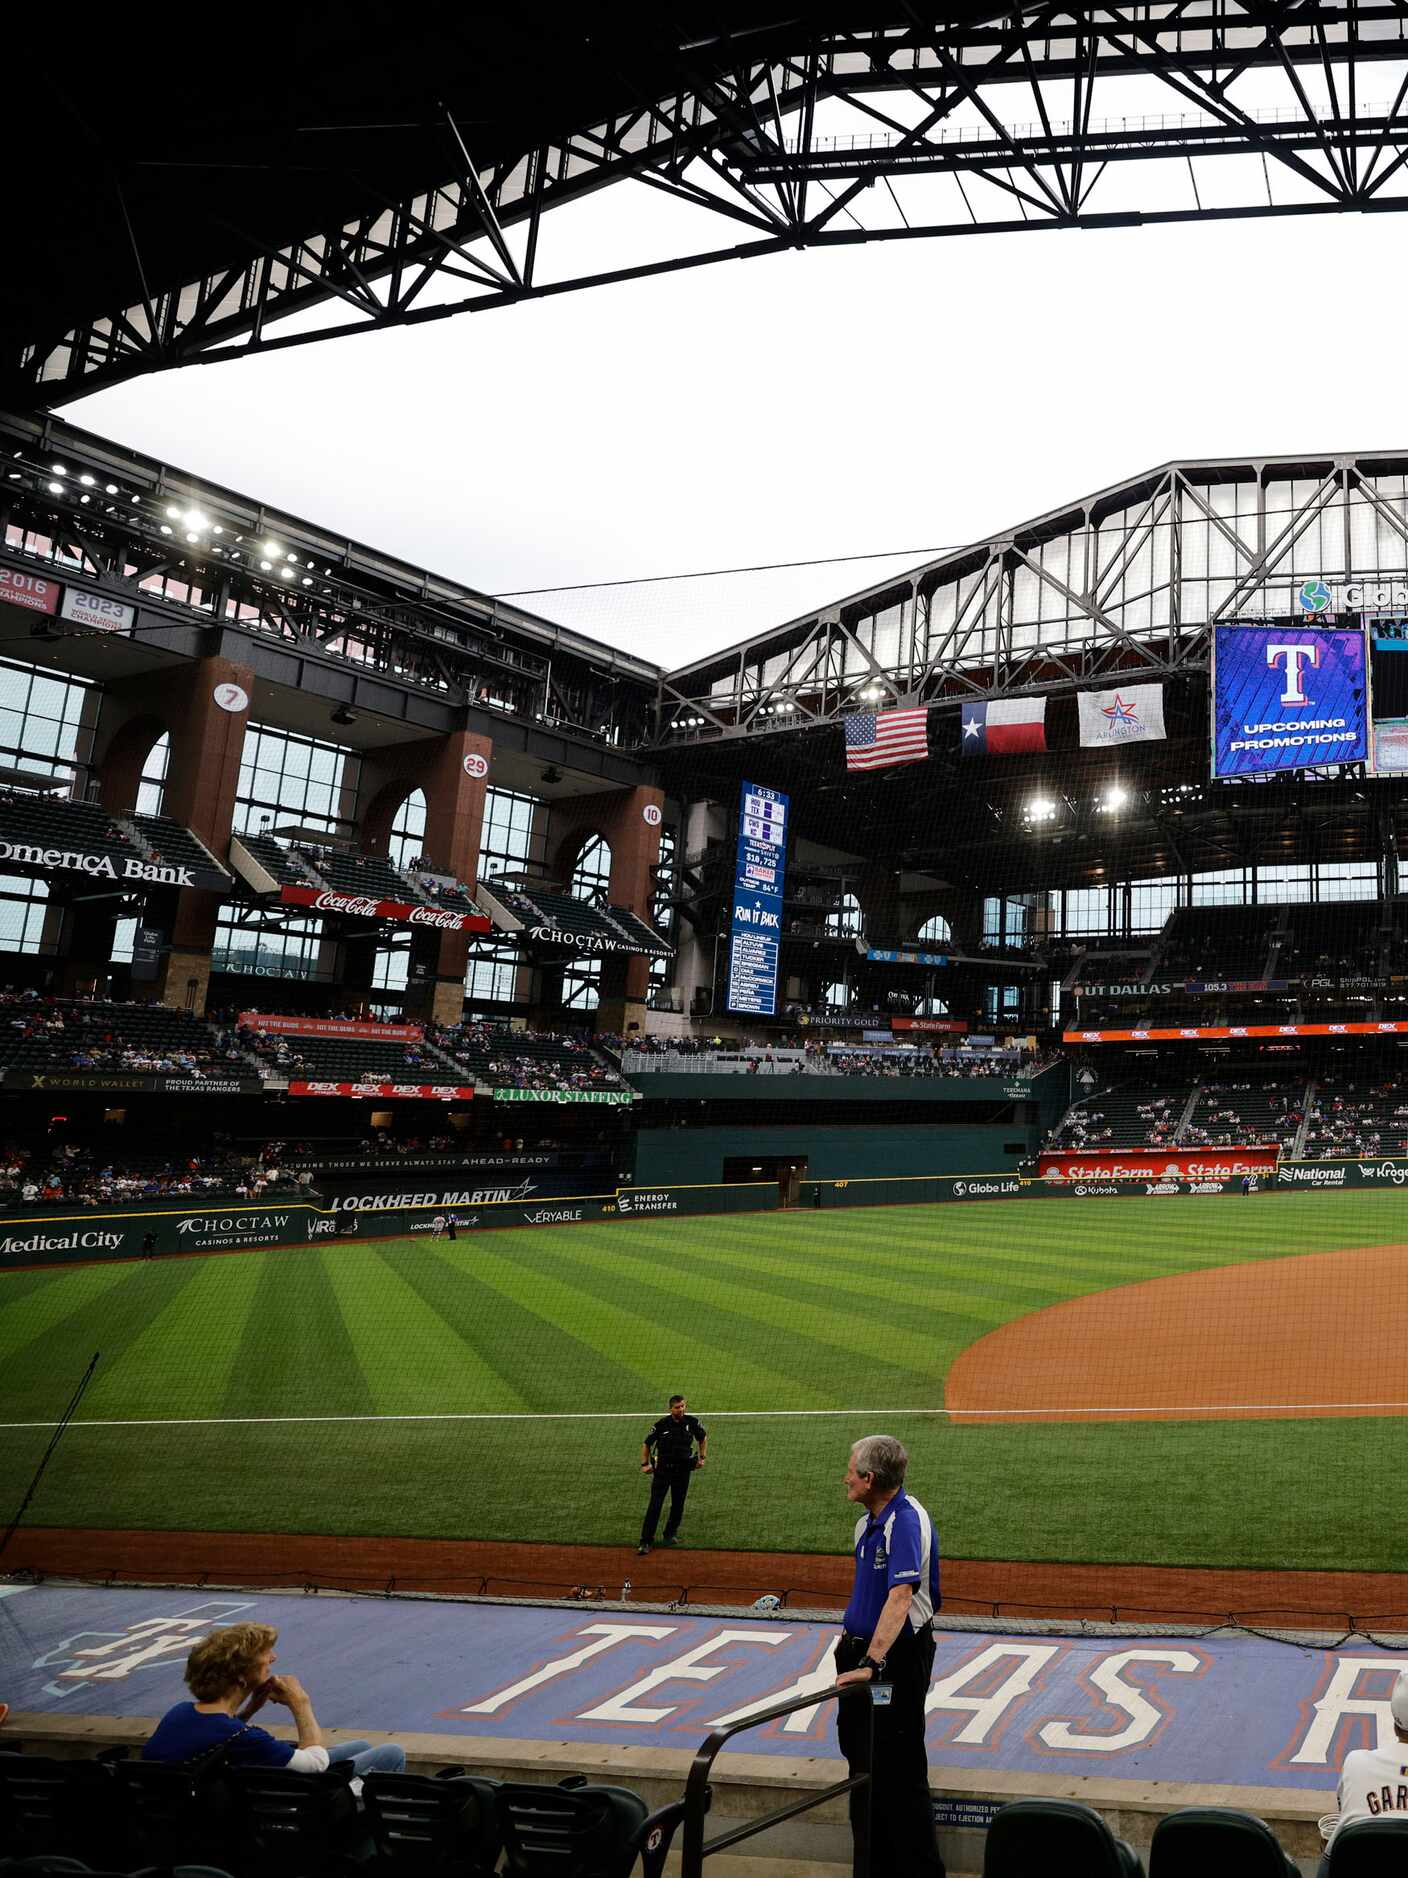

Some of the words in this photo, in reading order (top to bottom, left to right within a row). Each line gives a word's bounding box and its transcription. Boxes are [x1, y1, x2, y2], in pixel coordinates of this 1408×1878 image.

[0, 569, 47, 594] 2016
[75, 593, 124, 618] 2023
[225, 689, 238, 706] 7
[1244, 718, 1346, 734] UPCOMING
[1230, 732, 1357, 752] PROMOTIONS
[465, 757, 486, 773] 29
[757, 789, 775, 800] 6:33
[646, 807, 660, 823] 10
[122, 859, 197, 887] Bank
[315, 891, 378, 917] Coca-Cola
[408, 906, 466, 930] Coca-Cola
[760, 912, 779, 928] BACK
[538, 926, 617, 952] CHOCTAW
[1204, 983, 1227, 992] 105.3
[1312, 978, 1335, 987] PGL
[1085, 985, 1107, 996] UT
[1110, 983, 1171, 995] DALLAS
[810, 1016, 851, 1027] PRIORITY
[853, 1016, 880, 1027] GOLD
[1328, 1024, 1346, 1032] DEX
[1279, 1025, 1297, 1033] DEX
[50, 1078, 95, 1087] WORLD
[100, 1079, 145, 1088] WALLET
[307, 1082, 339, 1091] DEX
[351, 1083, 382, 1092] DEX
[392, 1085, 422, 1093] DEX
[431, 1086, 458, 1095] DEX
[508, 1089, 561, 1102] LUXOR
[561, 1090, 631, 1104] STAFFING
[404, 1159, 434, 1167] ALWAYS
[1294, 1167, 1345, 1180] National
[968, 1182, 1000, 1194] Globe
[1001, 1181, 1019, 1193] Life
[1087, 1186, 1118, 1194] Kubota
[330, 1192, 437, 1212] LOCKHEED
[441, 1189, 511, 1207] MARTIN
[634, 1194, 670, 1202] ENERGY
[634, 1202, 678, 1211] TRANSFER
[524, 1209, 583, 1223] VERYABLE
[188, 1215, 289, 1233] CHOCTAW
[0, 1232, 77, 1254] Medical
[81, 1231, 125, 1249] City
